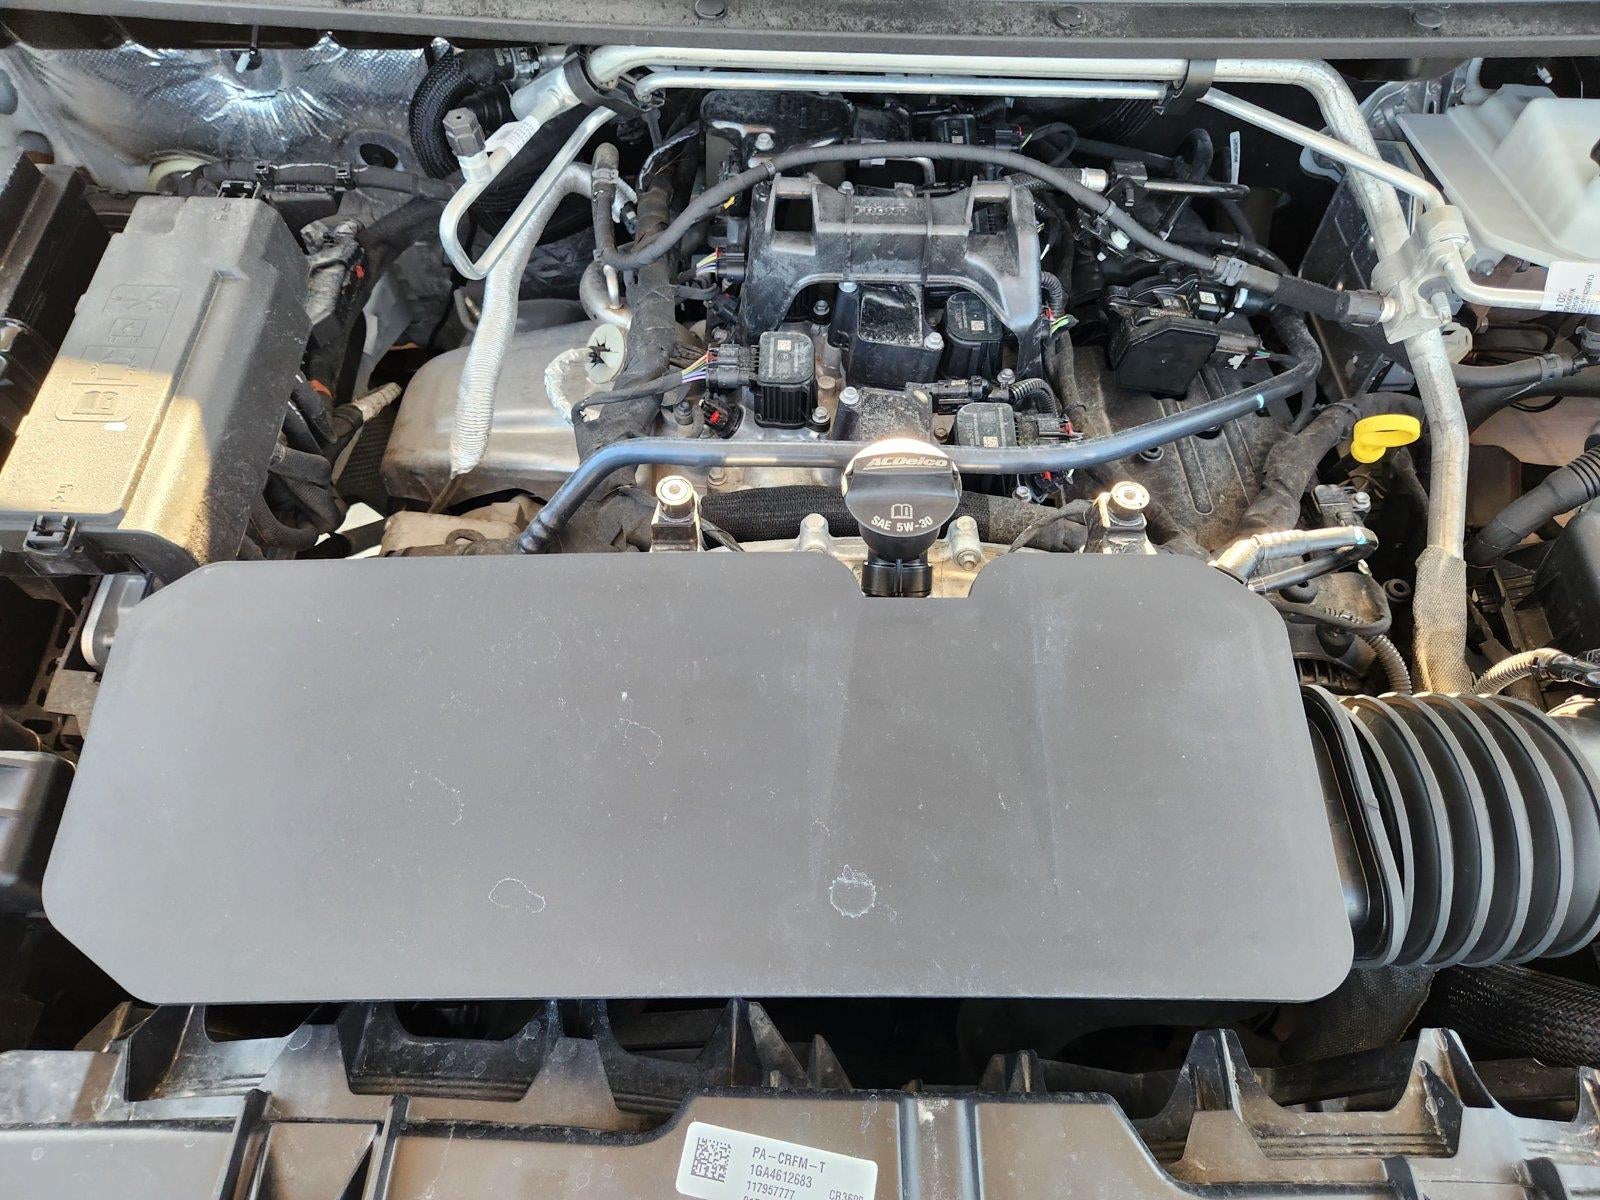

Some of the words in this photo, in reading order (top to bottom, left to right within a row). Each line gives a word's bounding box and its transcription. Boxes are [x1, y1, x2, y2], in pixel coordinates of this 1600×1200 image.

[866, 457, 948, 468] ACDelco
[871, 515, 892, 531] SAE
[896, 516, 933, 532] 5W-30
[752, 1146, 826, 1173] PA-CRFM-T
[750, 1164, 813, 1188] 1GA4612683
[747, 1181, 796, 1200] 117957777
